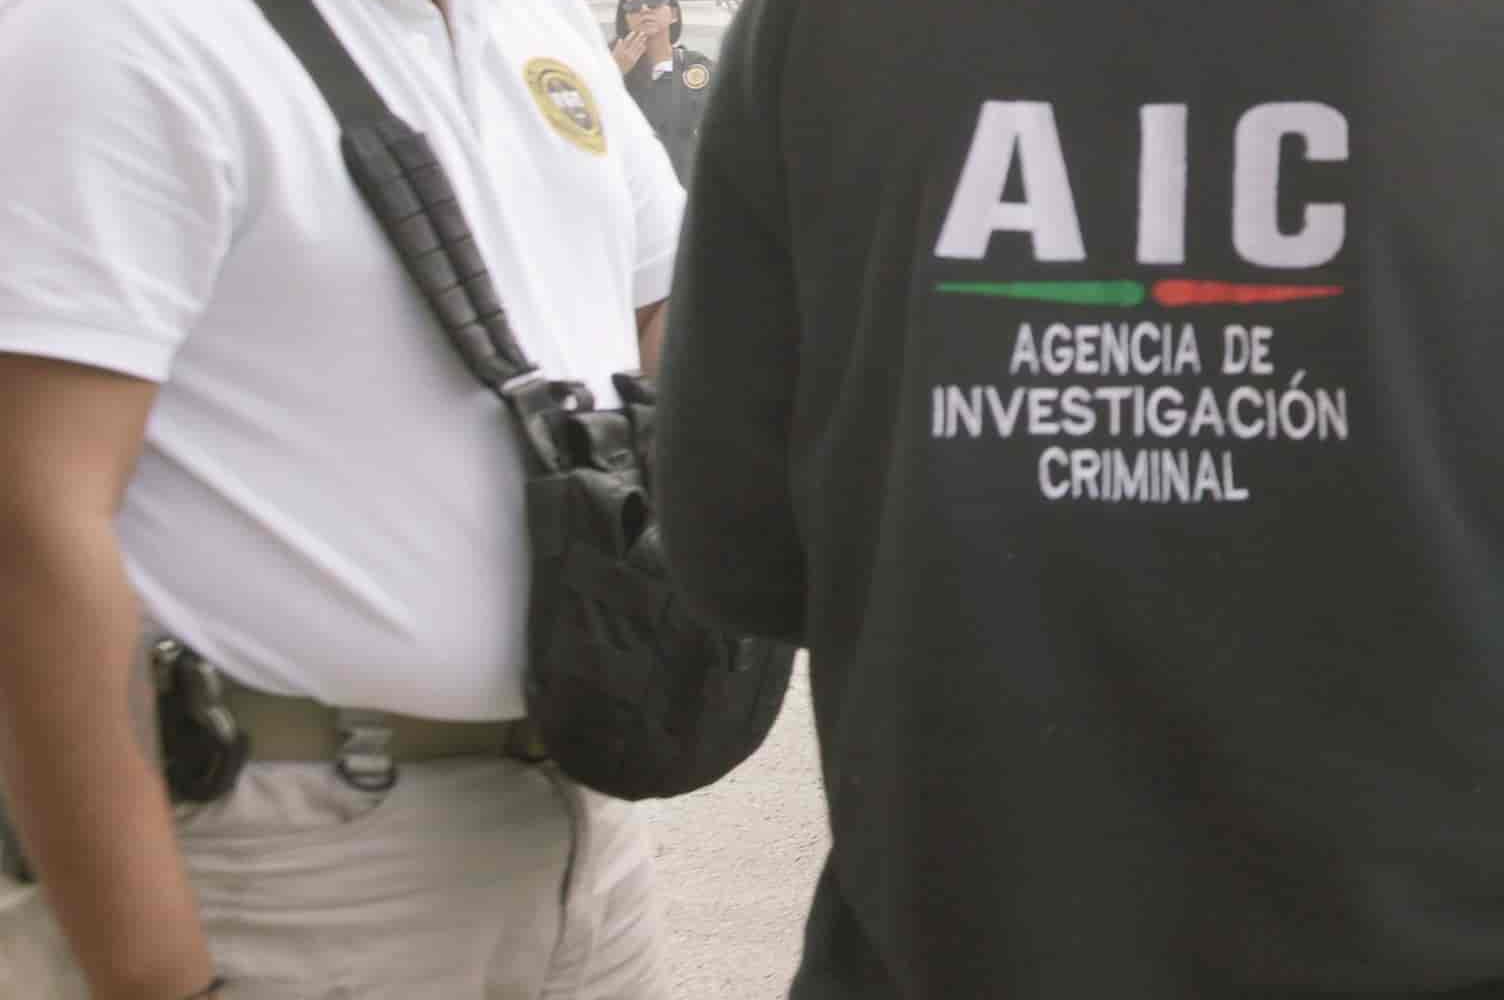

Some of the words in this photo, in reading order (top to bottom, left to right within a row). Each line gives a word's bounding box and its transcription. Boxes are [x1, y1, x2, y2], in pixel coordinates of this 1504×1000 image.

[934, 100, 1349, 268] AIC
[1009, 321, 1201, 376] AGENCIA
[1222, 324, 1274, 375] DE
[931, 369, 1348, 440] INVESTIGACIÓN
[1038, 446, 1249, 503] CRIMINAL
